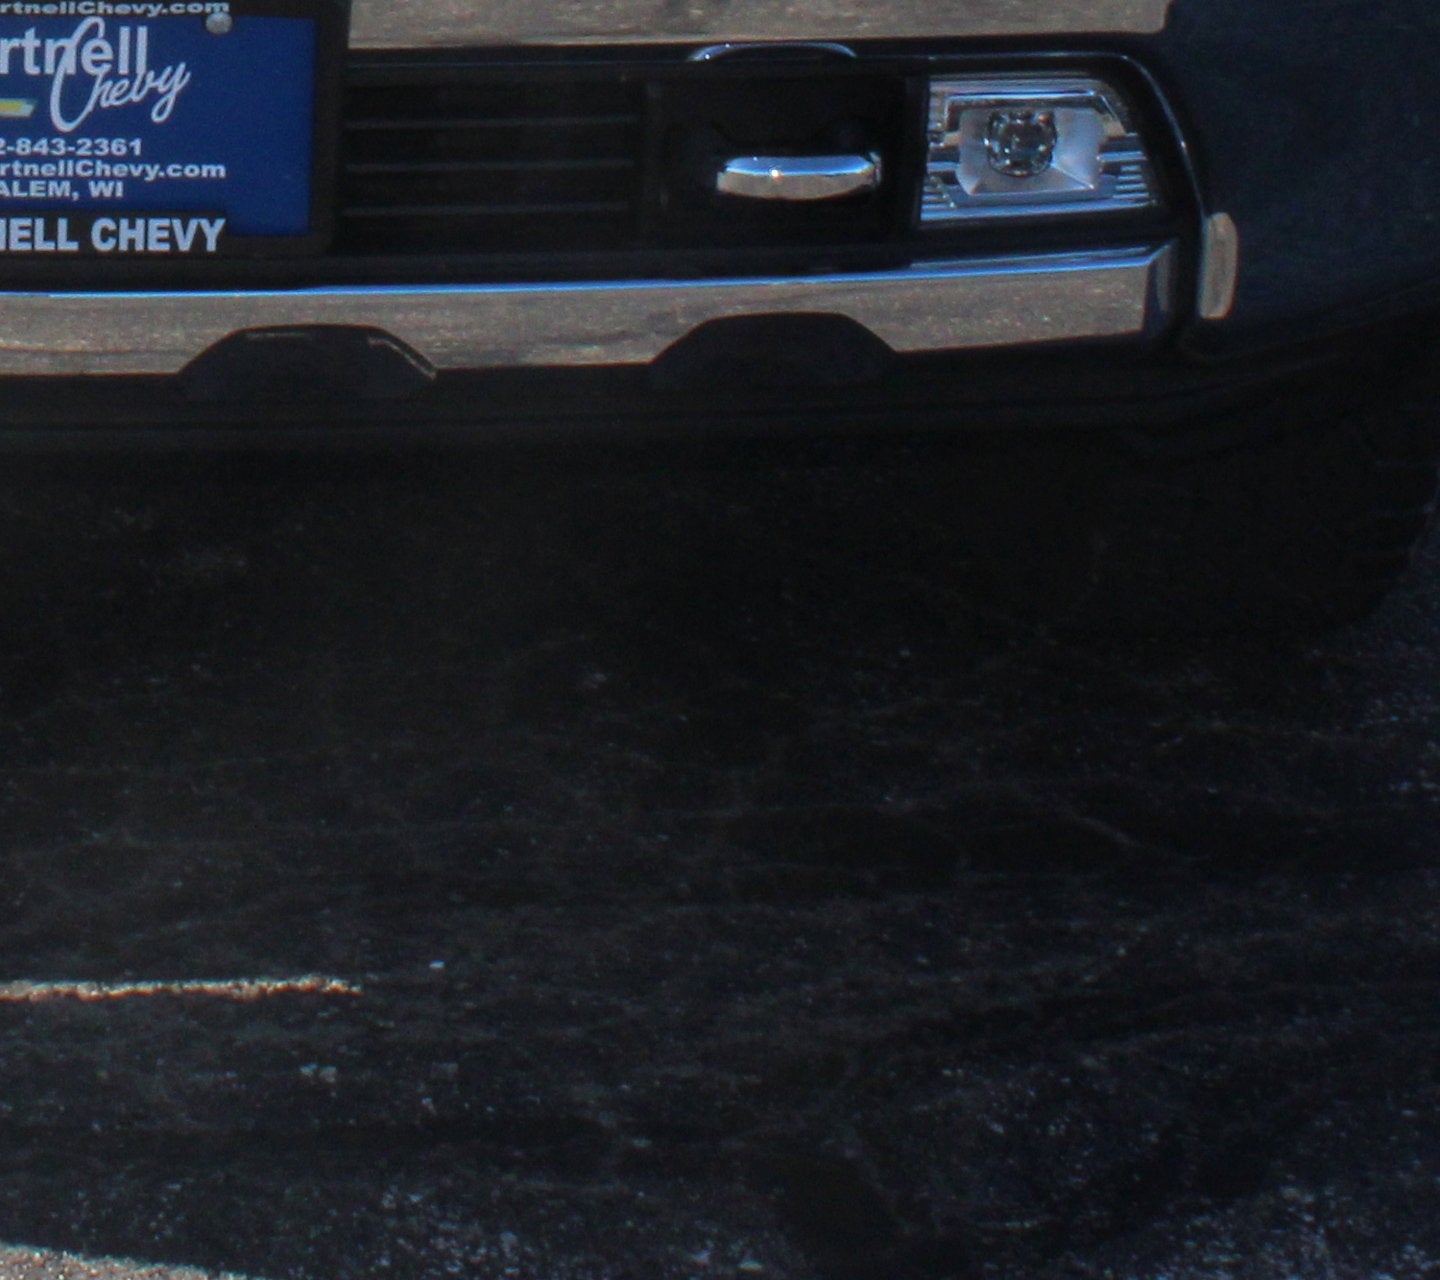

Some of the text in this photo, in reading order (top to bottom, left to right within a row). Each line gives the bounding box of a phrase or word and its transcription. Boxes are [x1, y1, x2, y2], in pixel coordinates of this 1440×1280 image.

[50, 16, 191, 132] Chevy
[88, 180, 124, 198] WI
[91, 217, 225, 252] CHEVY
